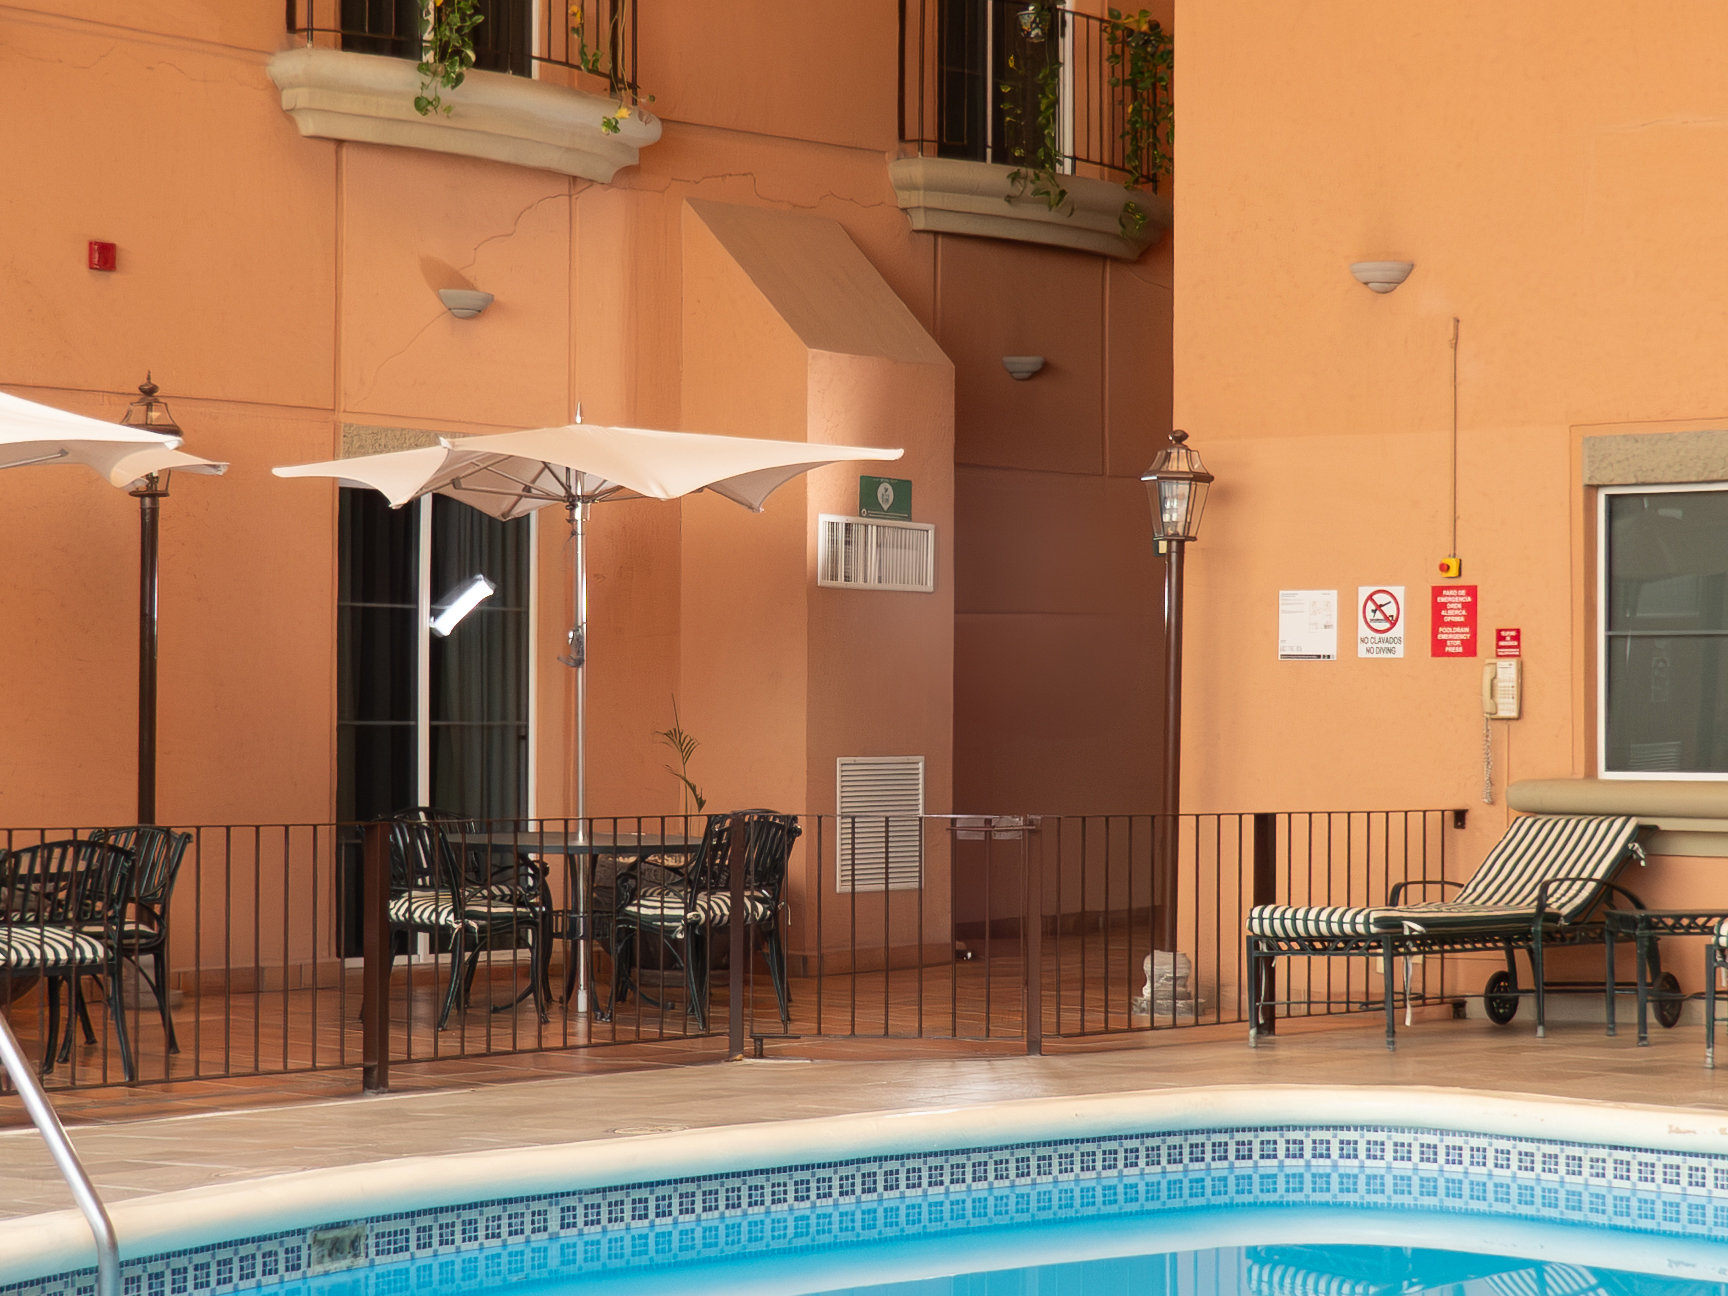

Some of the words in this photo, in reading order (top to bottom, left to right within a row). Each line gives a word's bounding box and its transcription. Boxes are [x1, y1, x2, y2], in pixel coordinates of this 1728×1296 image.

[1360, 636, 1369, 645] NO
[1370, 636, 1402, 645] CLAVADOS
[1365, 646, 1375, 655] NO
[1375, 646, 1397, 655] DIVING
